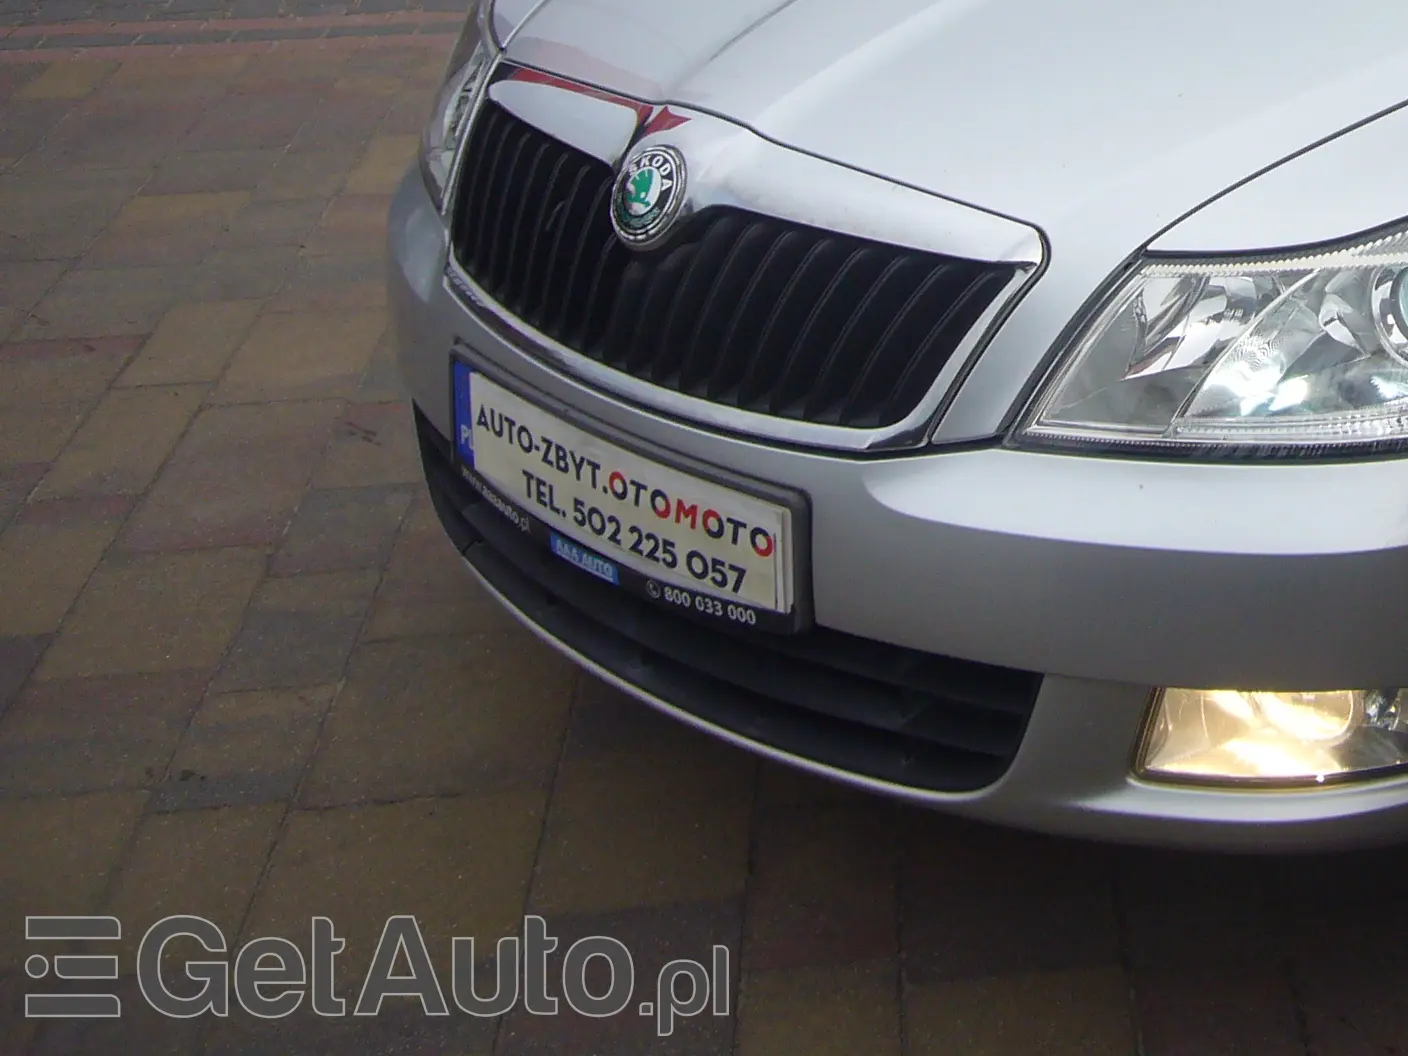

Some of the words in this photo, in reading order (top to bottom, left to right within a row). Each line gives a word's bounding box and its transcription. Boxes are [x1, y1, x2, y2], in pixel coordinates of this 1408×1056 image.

[477, 404, 774, 558] AUTO-ZBYT.OTOMOTO
[522, 469, 567, 518] TEL.
[628, 525, 678, 569] 225
[664, 586, 691, 608] 800
[695, 597, 723, 616] 033
[727, 604, 757, 626] 000
